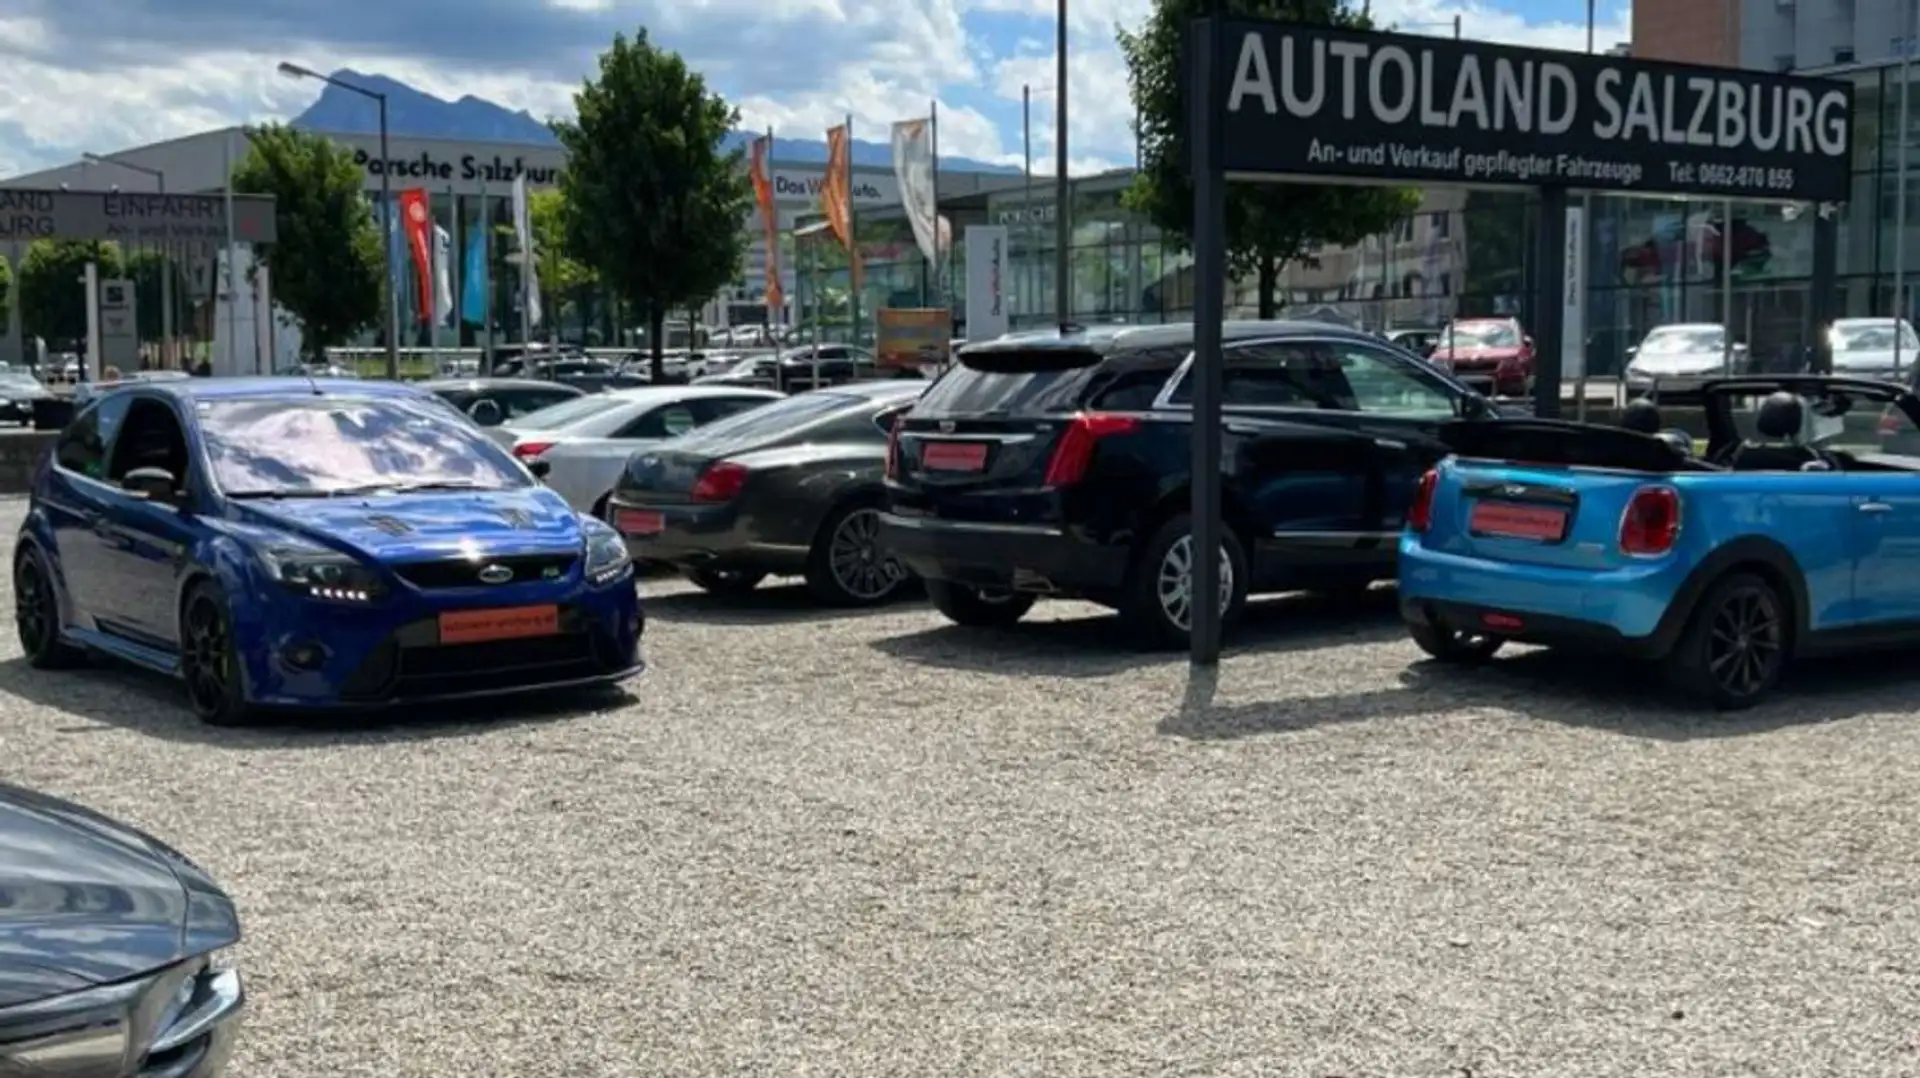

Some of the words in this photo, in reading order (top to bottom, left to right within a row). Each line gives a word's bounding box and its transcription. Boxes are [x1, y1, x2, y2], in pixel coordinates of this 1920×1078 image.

[1227, 31, 1578, 134] AUTOLAND
[1592, 67, 1847, 156] SALZBURG
[354, 149, 454, 178] Porsche
[461, 154, 556, 184] Salzbur
[1307, 137, 1343, 163] An-
[1347, 143, 1385, 166] und
[1390, 143, 1461, 170] Verkauf
[1464, 149, 1553, 180] gepflegter
[1556, 154, 1643, 184] Fahrzeuge
